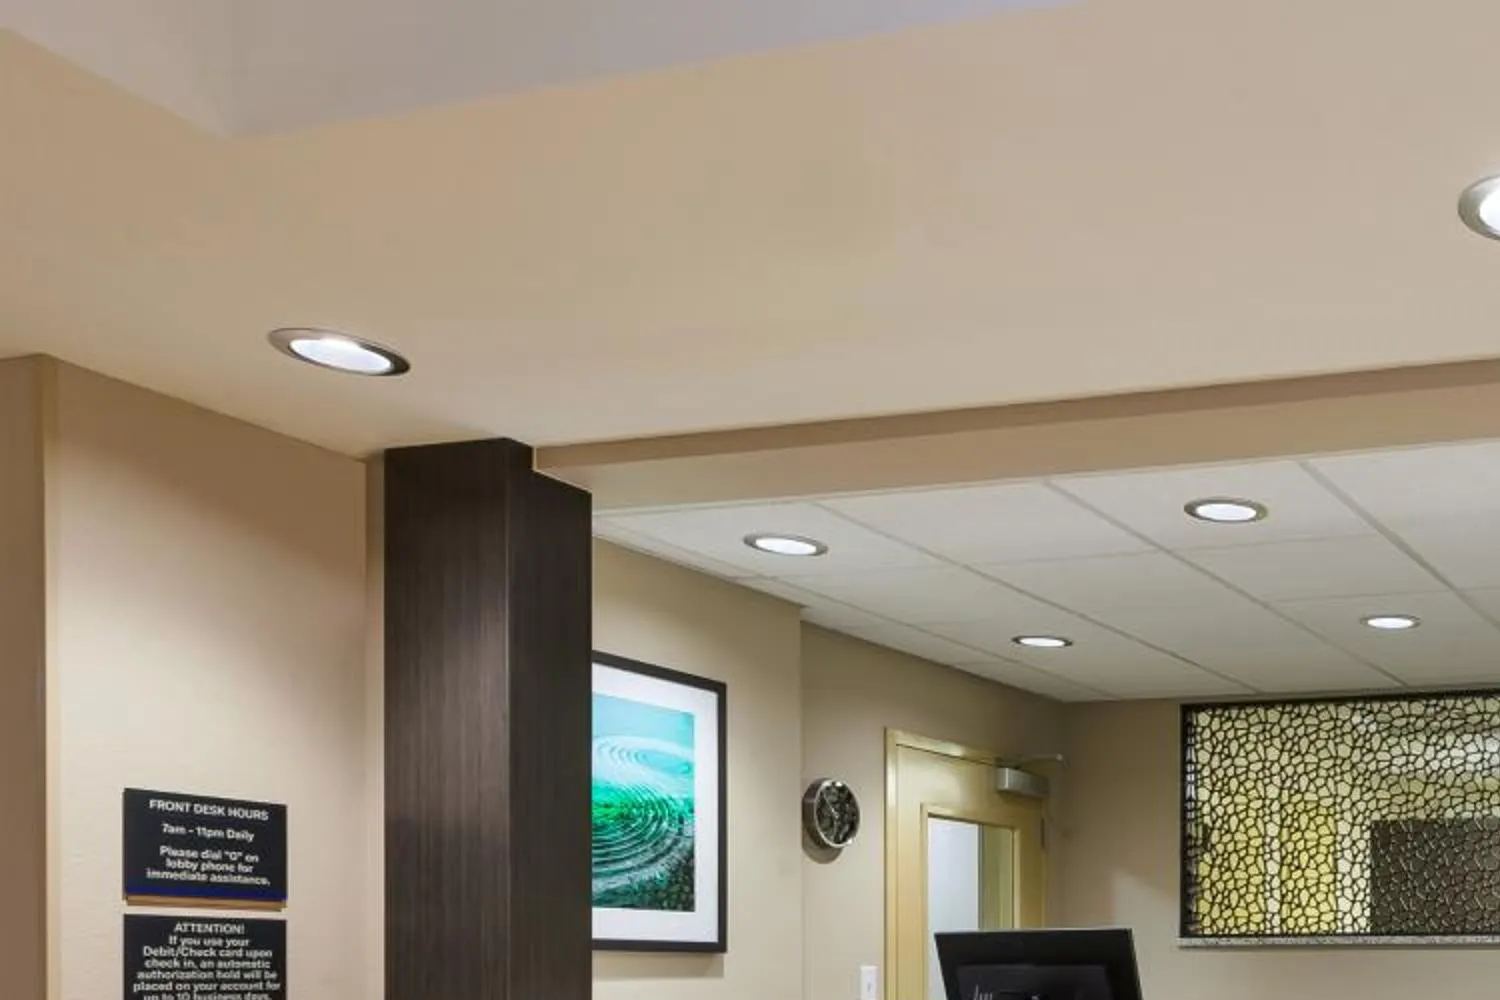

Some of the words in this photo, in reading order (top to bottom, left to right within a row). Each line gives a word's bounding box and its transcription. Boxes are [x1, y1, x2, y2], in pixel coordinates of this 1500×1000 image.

[149, 799, 190, 812] FRONT
[194, 803, 226, 816] DESK
[228, 807, 269, 821] HOURS
[162, 822, 187, 835] 7am
[196, 826, 225, 839] 11pm
[227, 828, 255, 842] Daily
[159, 845, 198, 859] Please
[201, 849, 222, 860] dial
[245, 854, 260, 863] on
[166, 858, 198, 872] lobby
[201, 862, 236, 873] phone
[238, 863, 254, 873] for
[145, 868, 208, 882] immediate
[174, 921, 245, 935] ATTENTION!
[169, 935, 178, 945] If
[179, 936, 200, 947] you
[203, 938, 224, 947] use
[225, 938, 249, 949] your
[143, 945, 216, 957] Debit/Check
[219, 947, 243, 957] card
[246, 950, 273, 959] upon
[144, 957, 181, 968] check
[200, 959, 215, 968] an
[217, 959, 271, 969] automatic
[137, 969, 214, 980] authorization
[216, 970, 241, 980] hold
[243, 970, 261, 980] will
[264, 970, 278, 980] be
[133, 981, 173, 993] placed
[175, 983, 191, 992] on
[193, 982, 218, 993] your
[219, 981, 263, 992] account
[265, 980, 281, 991] for
